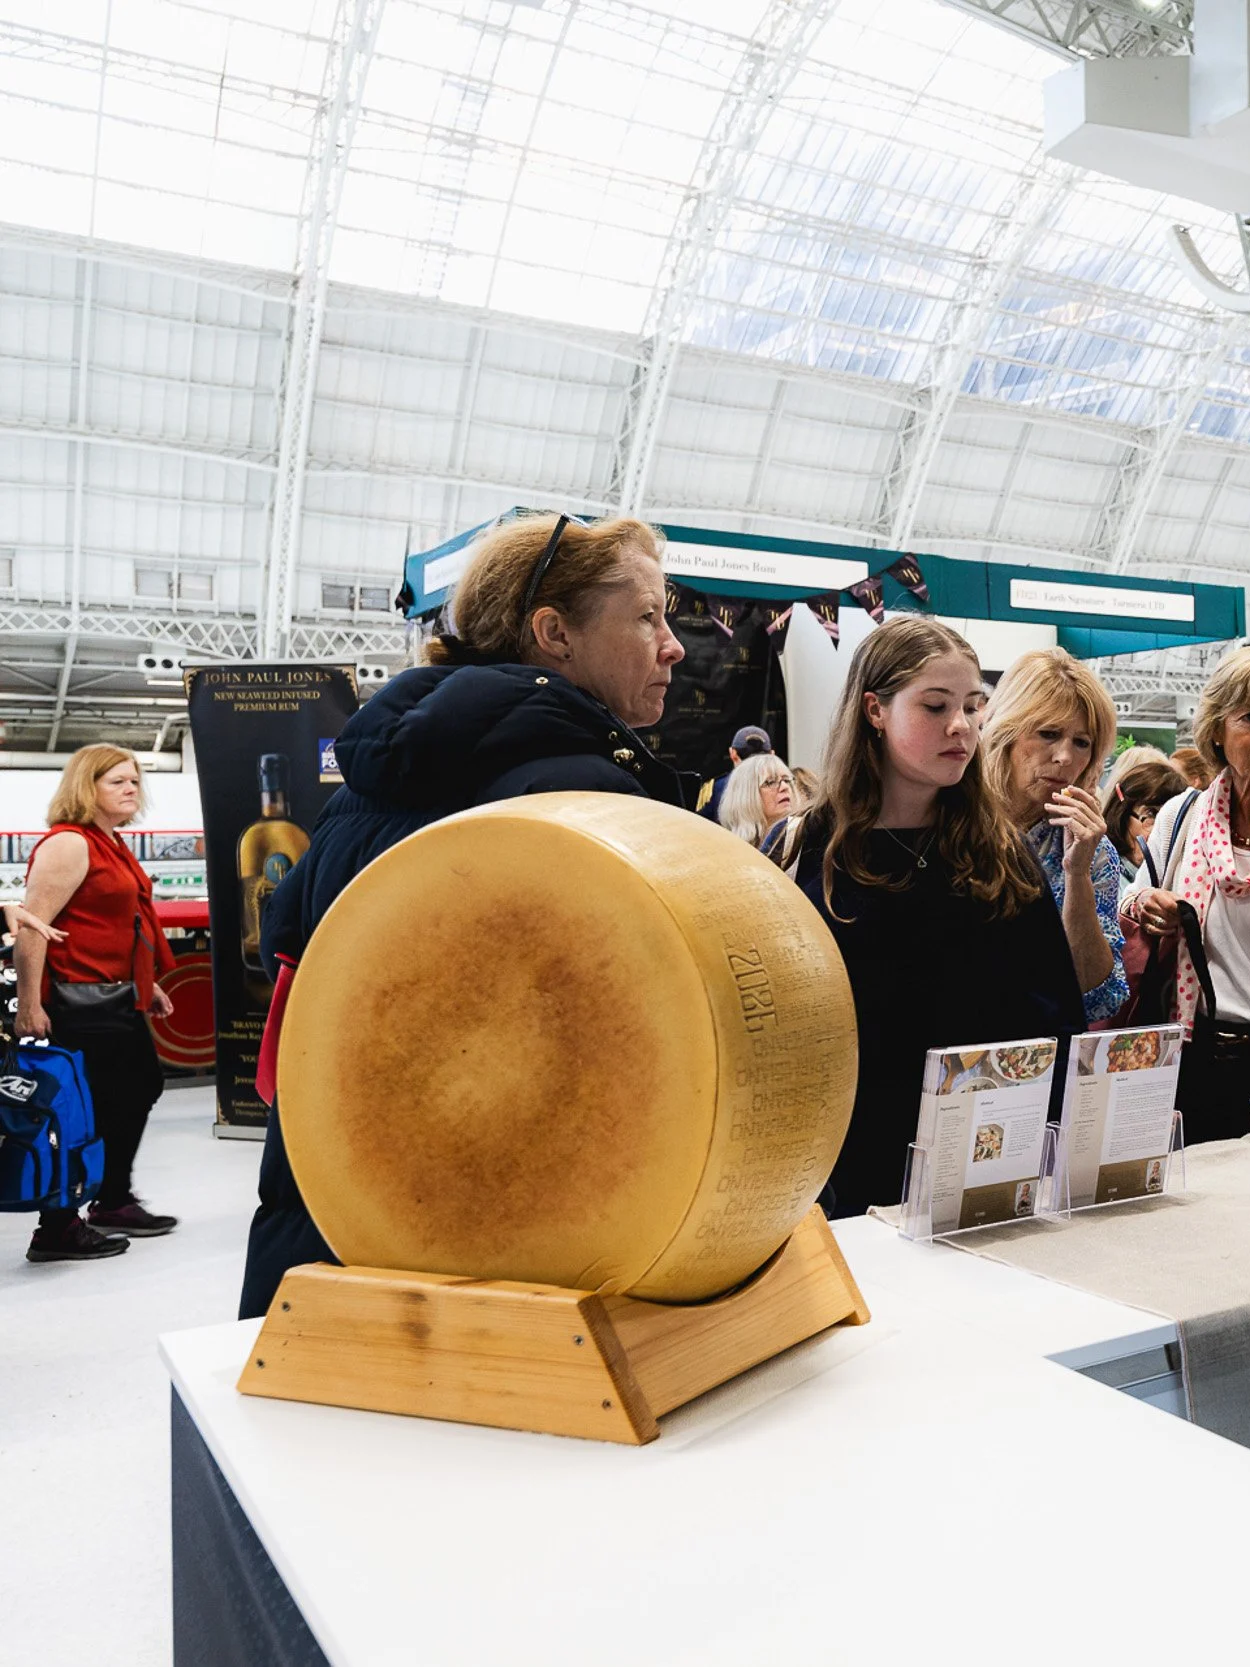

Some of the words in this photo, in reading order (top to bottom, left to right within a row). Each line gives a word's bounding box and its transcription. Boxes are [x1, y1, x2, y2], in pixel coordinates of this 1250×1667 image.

[667, 553, 691, 566] John
[694, 556, 718, 568] Paul
[721, 559, 750, 571] Jones
[204, 673, 241, 685] JOHN
[247, 672, 282, 683] PAUL
[286, 671, 332, 684] JONES
[214, 691, 234, 700] NEW
[237, 691, 280, 700] SEAWEED
[281, 690, 320, 699] INFUSED
[234, 702, 276, 711] PREMIUM
[278, 702, 299, 711] RUM
